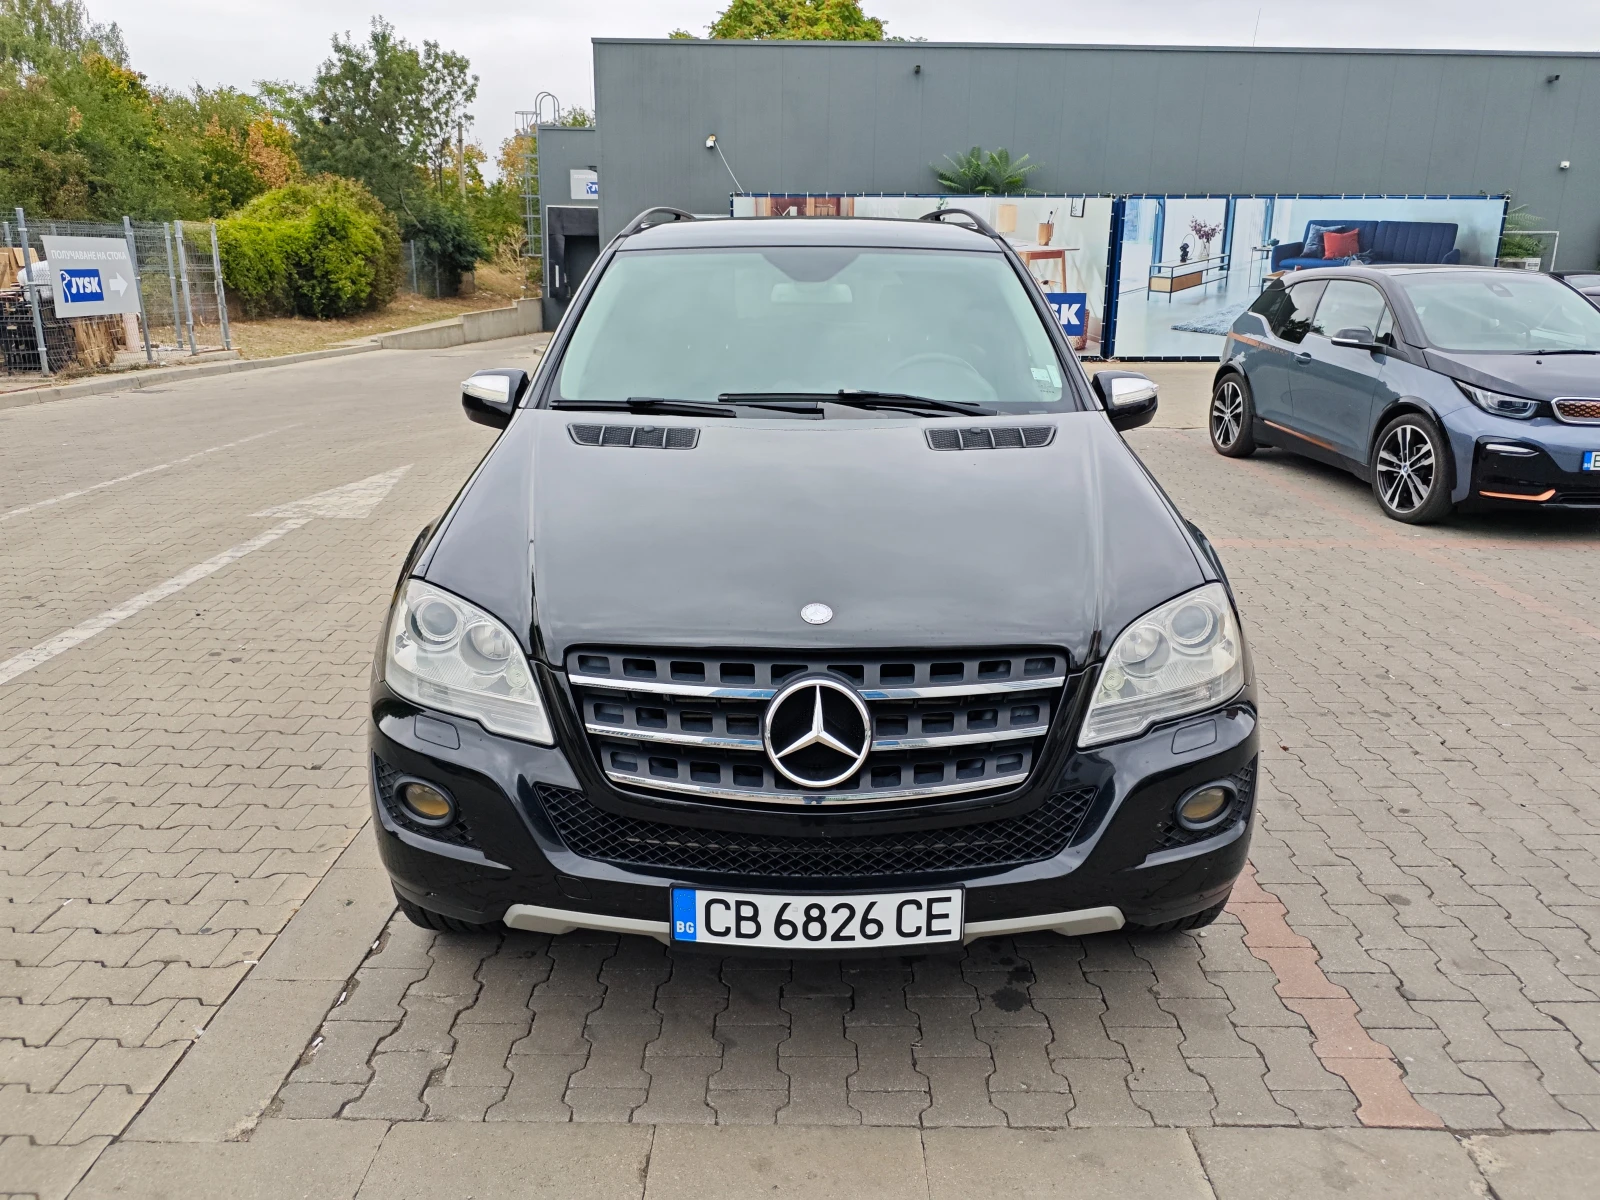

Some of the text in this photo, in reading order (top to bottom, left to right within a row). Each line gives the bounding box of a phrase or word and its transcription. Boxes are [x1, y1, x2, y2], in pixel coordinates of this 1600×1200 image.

[51, 250, 127, 260] ПОЛУЧАВАНЕ НА СТОКА
[71, 277, 102, 294] JYSK
[704, 896, 952, 942] CB 6826 CE
[676, 920, 695, 934] BG
